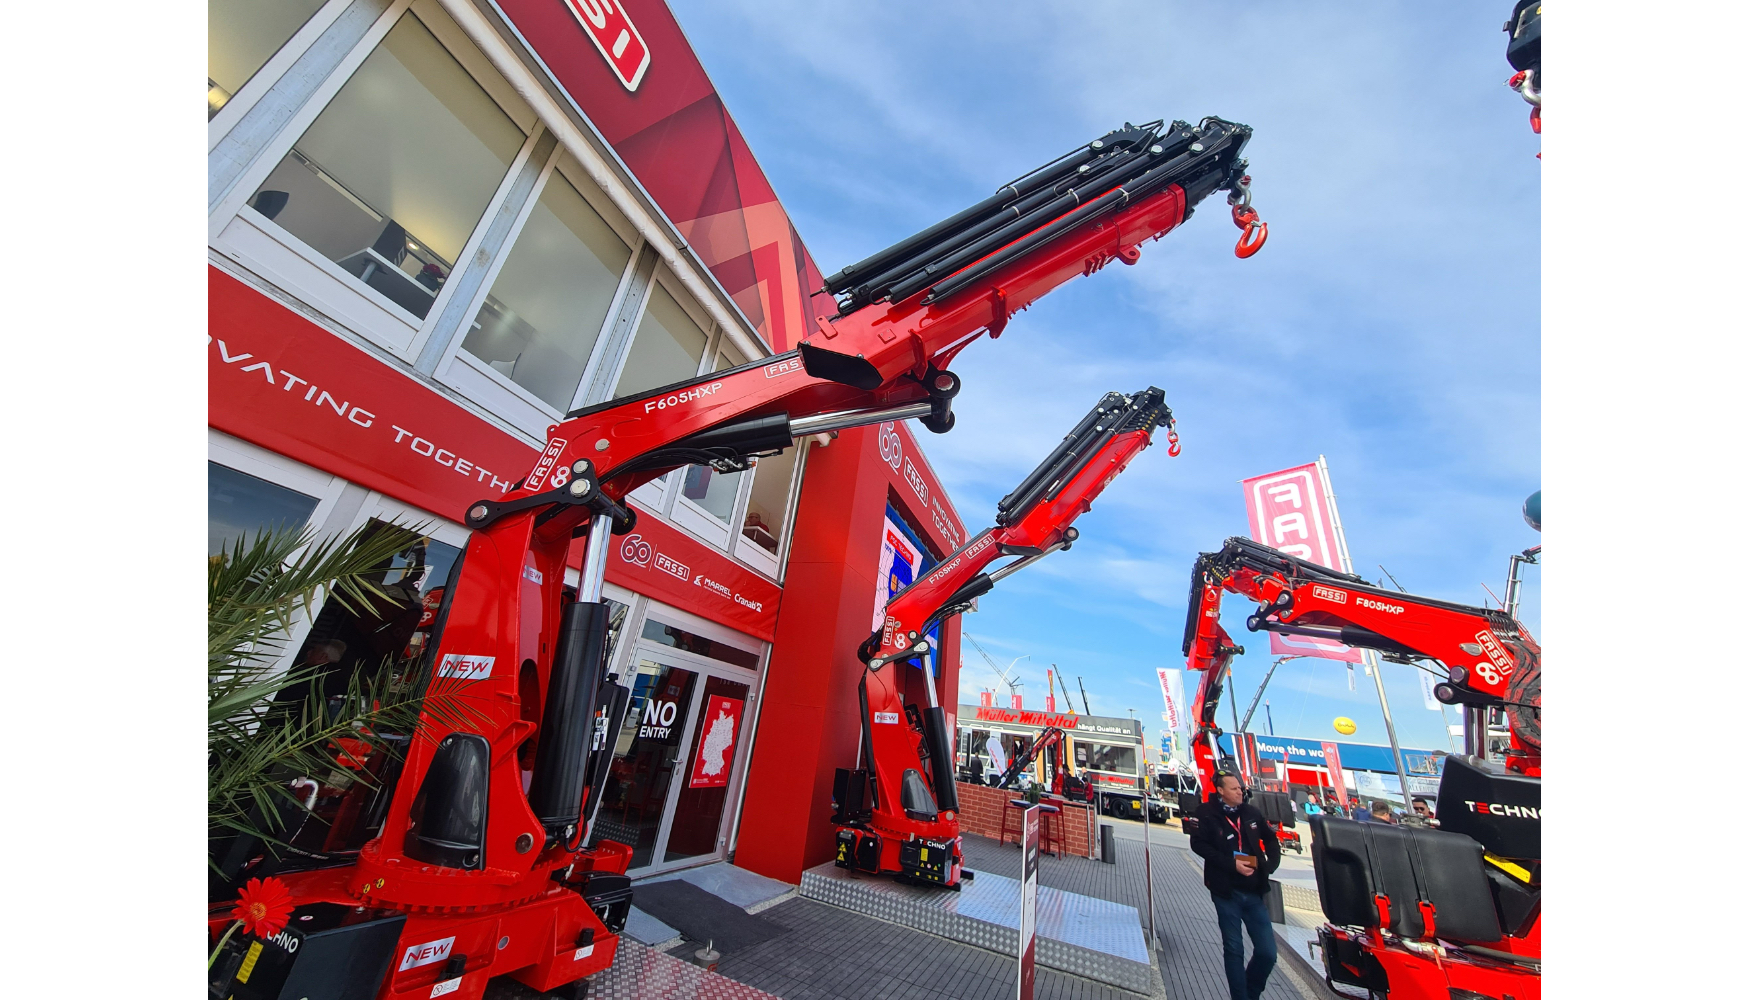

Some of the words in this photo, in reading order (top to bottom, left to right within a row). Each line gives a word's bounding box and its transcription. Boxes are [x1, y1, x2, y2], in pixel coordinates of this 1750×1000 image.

[769, 360, 803, 375] FAS
[644, 382, 723, 414] F605HXP
[208, 334, 376, 428] VATING
[391, 424, 514, 494] TOGETH
[529, 442, 563, 486] FASSI
[906, 462, 928, 502] FASSI
[620, 534, 652, 564] 60
[968, 537, 992, 556] FASSI
[657, 556, 688, 578] FASSI
[928, 558, 961, 585] F705HXP
[704, 578, 732, 597] MARREL
[1315, 588, 1344, 601] FASSI
[734, 594, 756, 610] Cranab
[1356, 597, 1404, 615] F805HXP
[884, 617, 893, 643] FASSI
[1479, 635, 1510, 670] FASSI
[443, 660, 489, 673] NEW
[642, 699, 677, 727] NO
[975, 707, 1017, 723] Müller
[1018, 711, 1080, 729] Mitteltal
[638, 725, 671, 739] ENTRY
[1257, 742, 1285, 754] Move
[1286, 745, 1306, 756] the
[1464, 800, 1541, 819] TECHN
[918, 838, 946, 850] TECHNO
[405, 942, 450, 964] NEW
